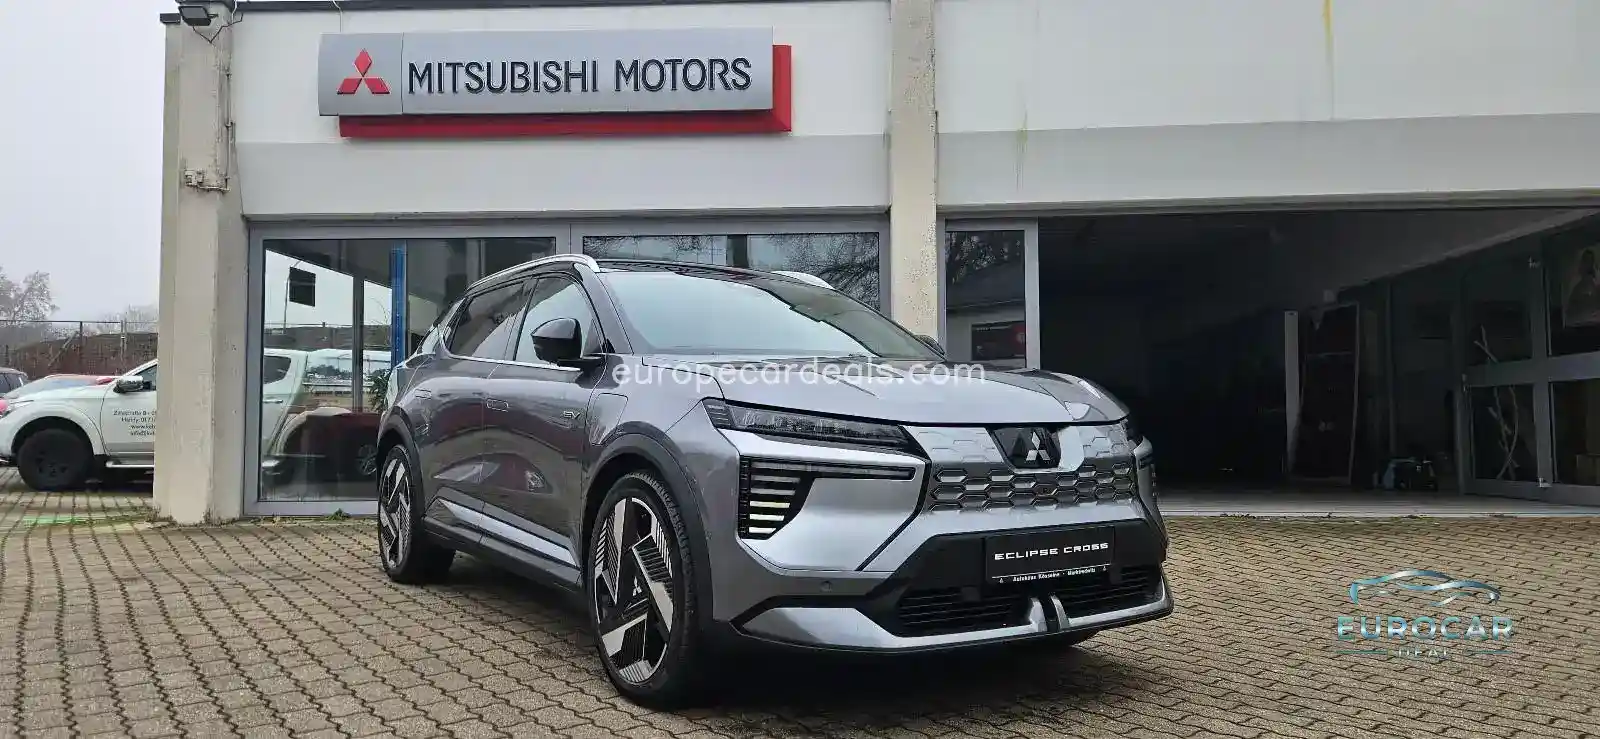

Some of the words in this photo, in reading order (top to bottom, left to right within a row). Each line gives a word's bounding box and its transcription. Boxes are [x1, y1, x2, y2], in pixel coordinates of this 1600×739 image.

[407, 59, 600, 95] MITSUBISHI
[614, 56, 753, 92] MOTORS
[994, 547, 1059, 561] ECLIPSE
[1063, 542, 1109, 554] CROSS
